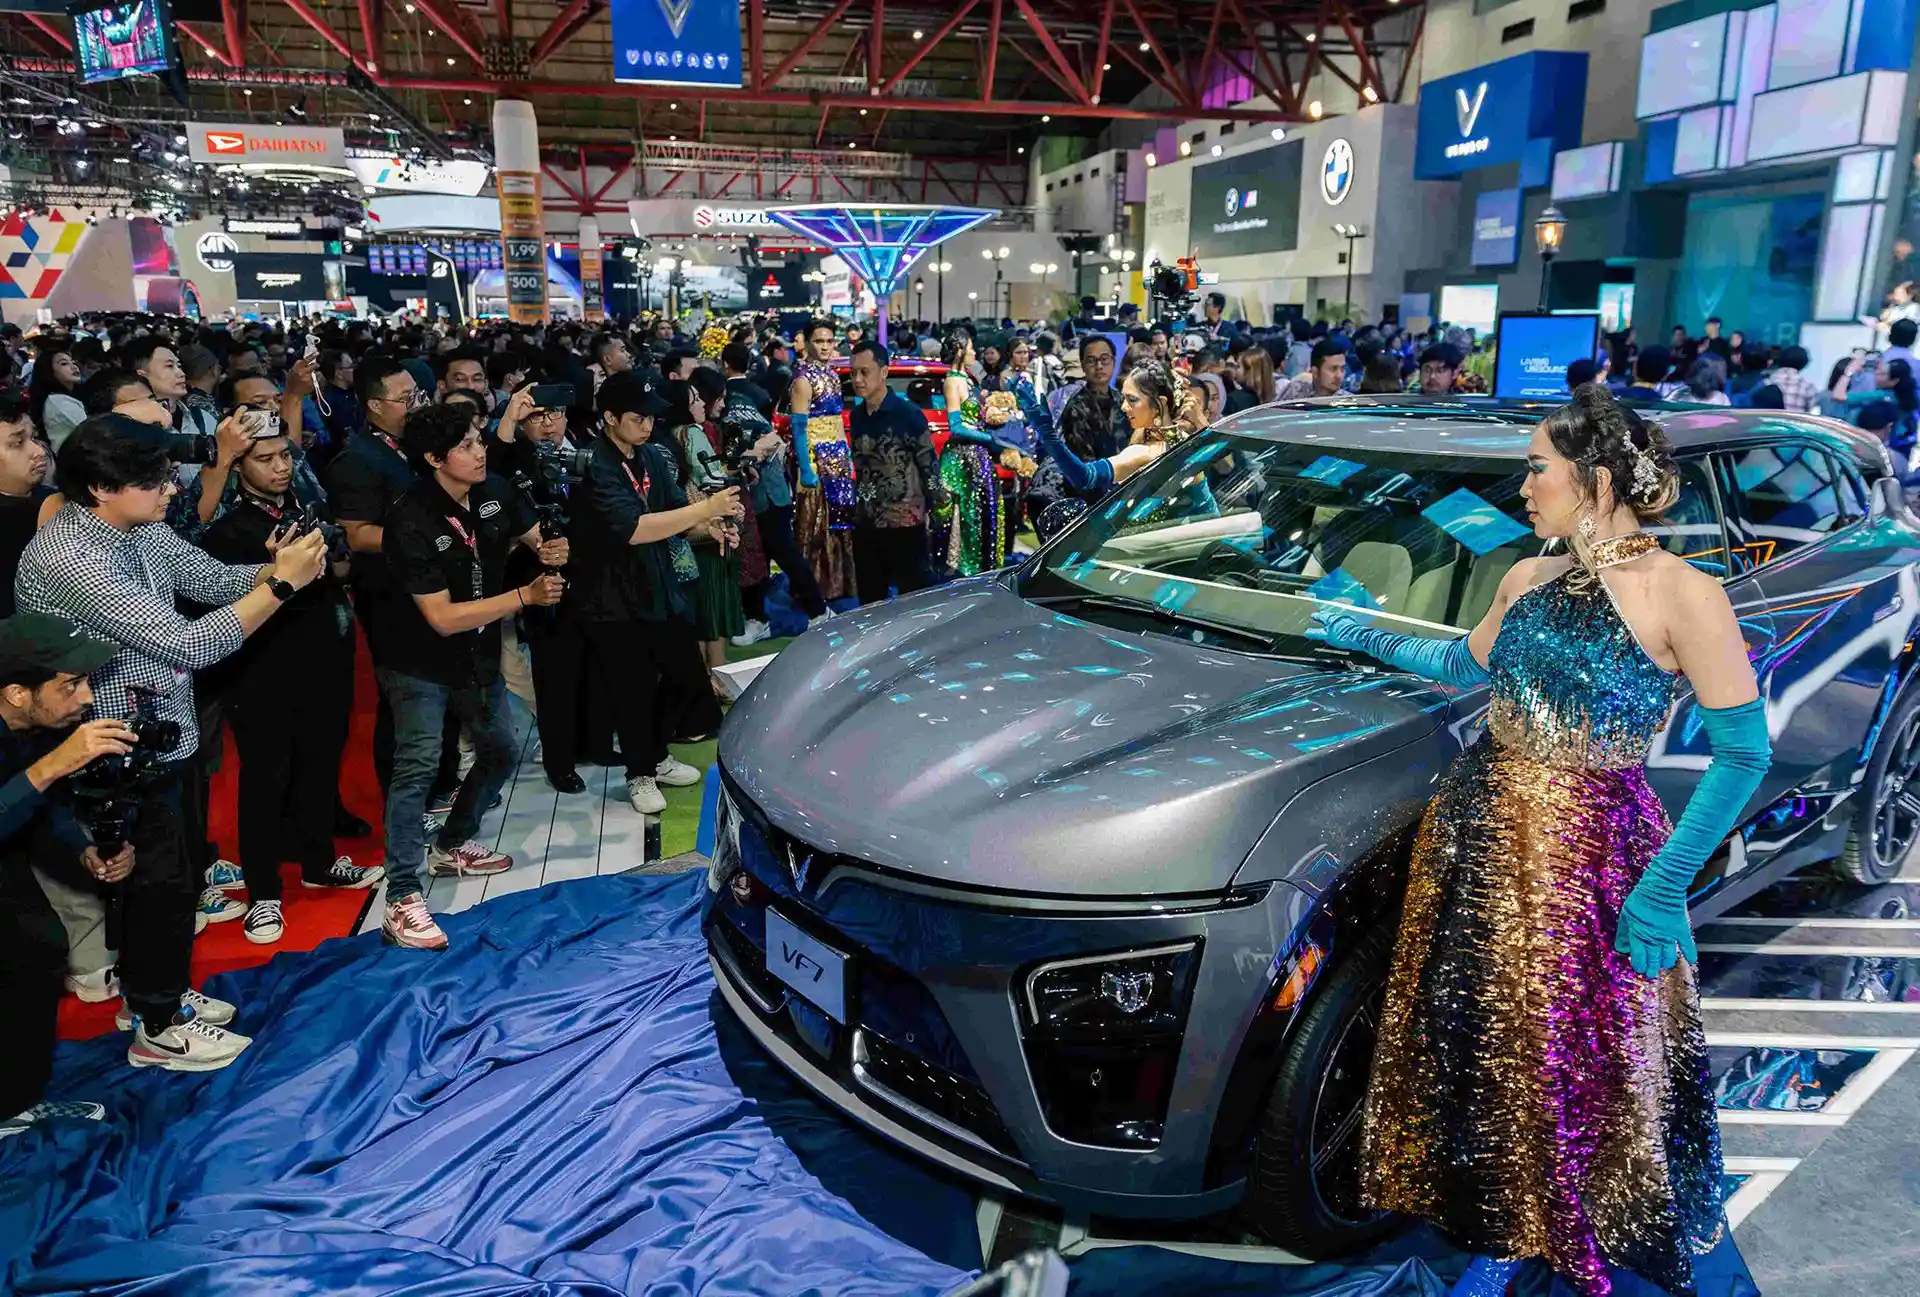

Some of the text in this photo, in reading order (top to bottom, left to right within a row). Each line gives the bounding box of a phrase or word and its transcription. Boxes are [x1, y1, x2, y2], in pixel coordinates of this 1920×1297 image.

[626, 49, 729, 70] VINFAST
[248, 136, 327, 154] DAIHATSU
[718, 210, 775, 225] SUZU
[782, 941, 824, 983] VF7
